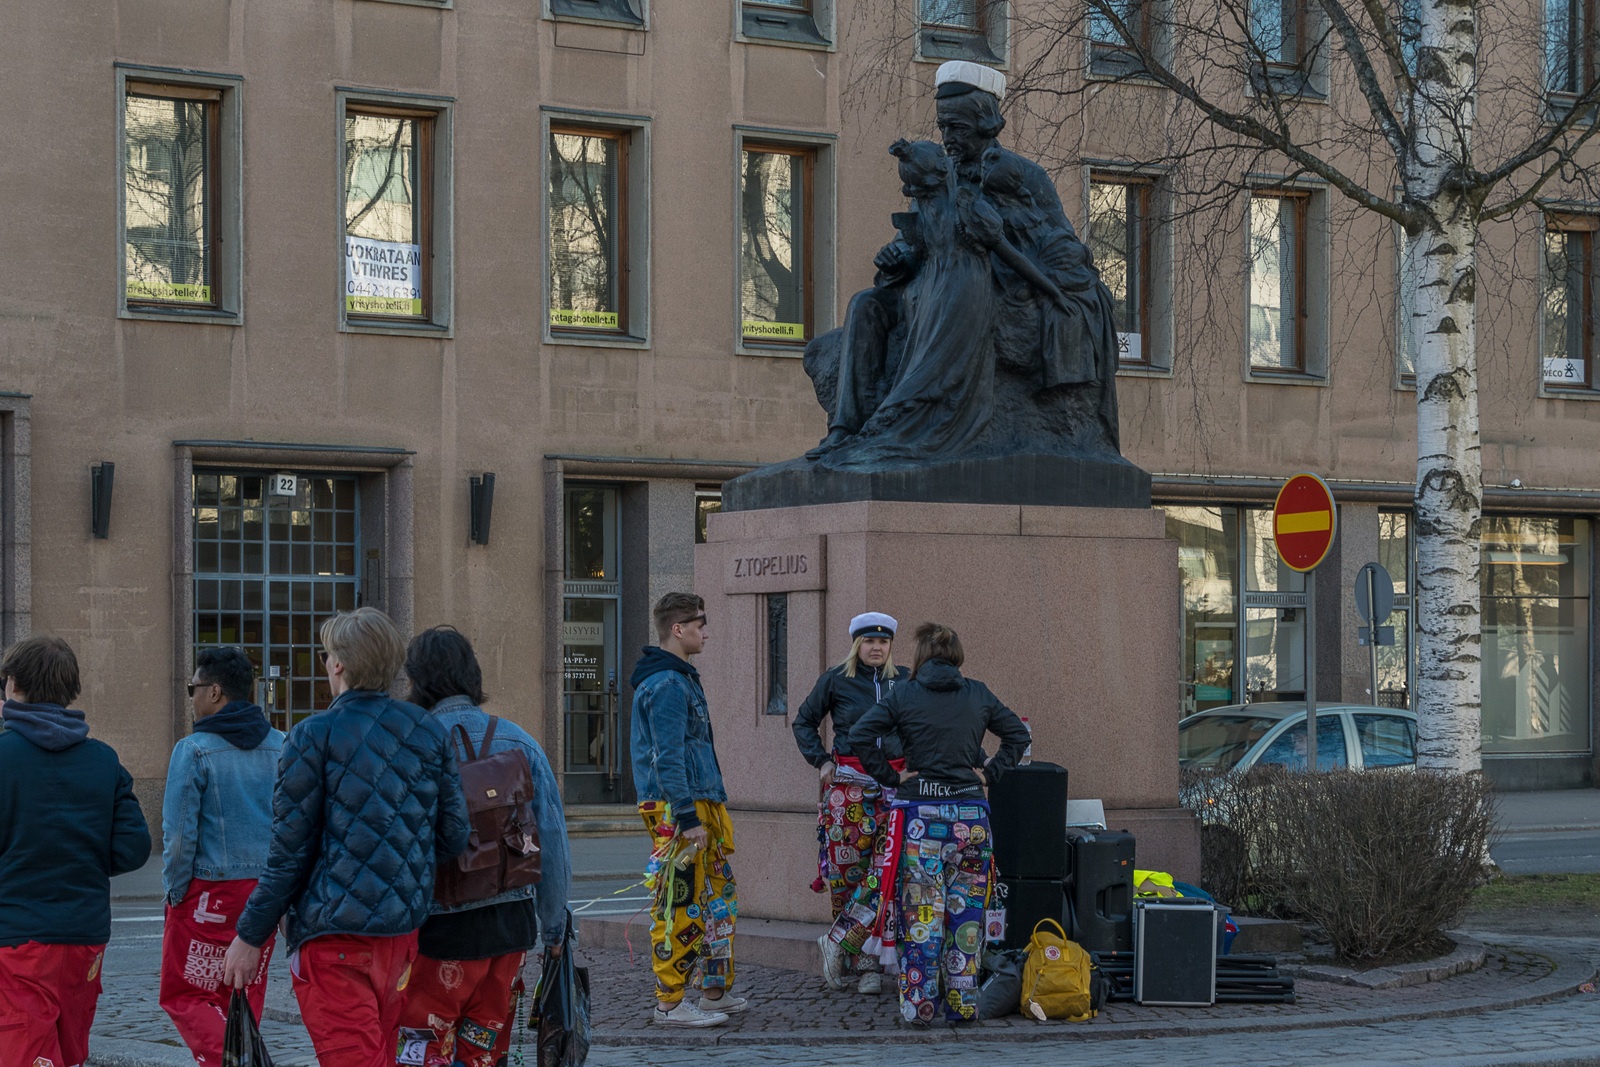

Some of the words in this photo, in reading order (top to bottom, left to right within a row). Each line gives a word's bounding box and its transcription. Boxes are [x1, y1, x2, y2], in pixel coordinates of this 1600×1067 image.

[352, 260, 408, 281] UTHYRES
[742, 324, 794, 335] yrityshotelli.fi
[280, 478, 293, 490] 22
